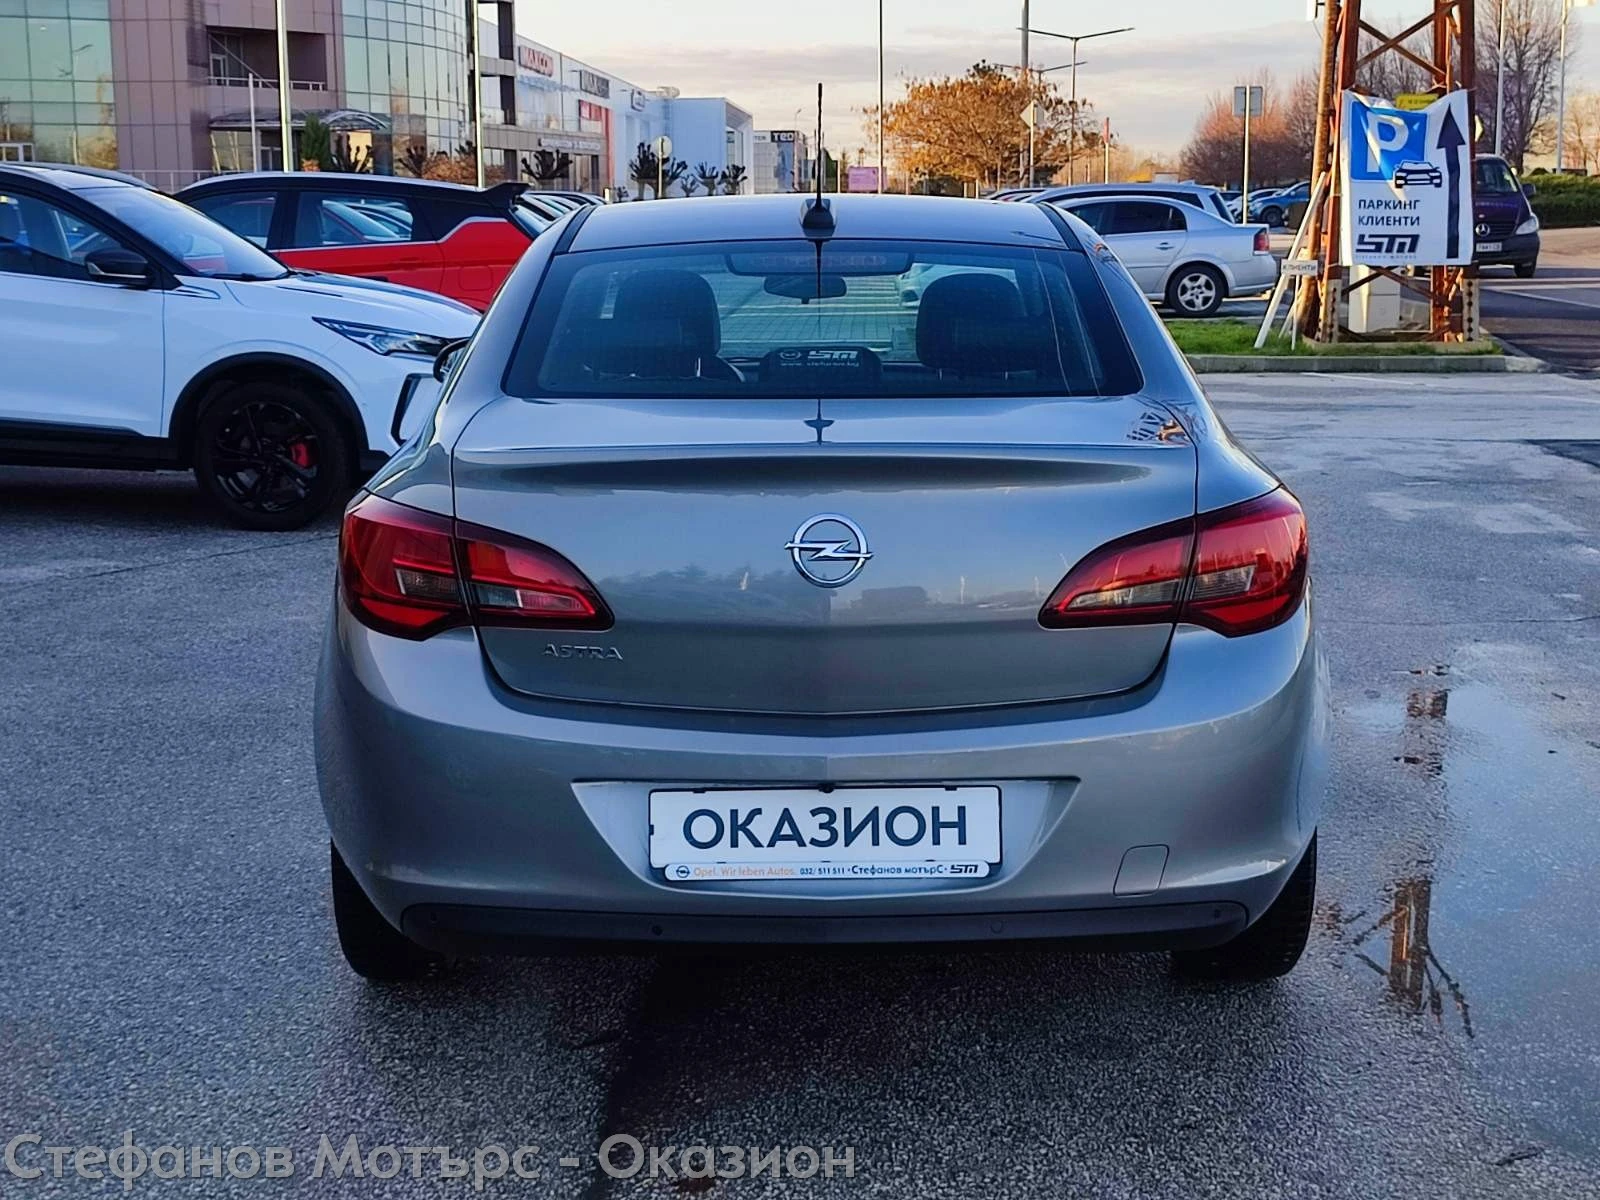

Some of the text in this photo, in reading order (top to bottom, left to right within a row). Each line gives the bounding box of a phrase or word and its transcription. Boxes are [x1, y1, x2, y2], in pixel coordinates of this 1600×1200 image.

[1358, 199, 1420, 210] ПАРКИНГ
[1358, 215, 1420, 226] КЛИЕНТИ
[543, 643, 623, 660] ASTRA
[683, 805, 967, 850] ОКАЗИОН
[818, 866, 831, 874] 511
[832, 866, 845, 874] 511
